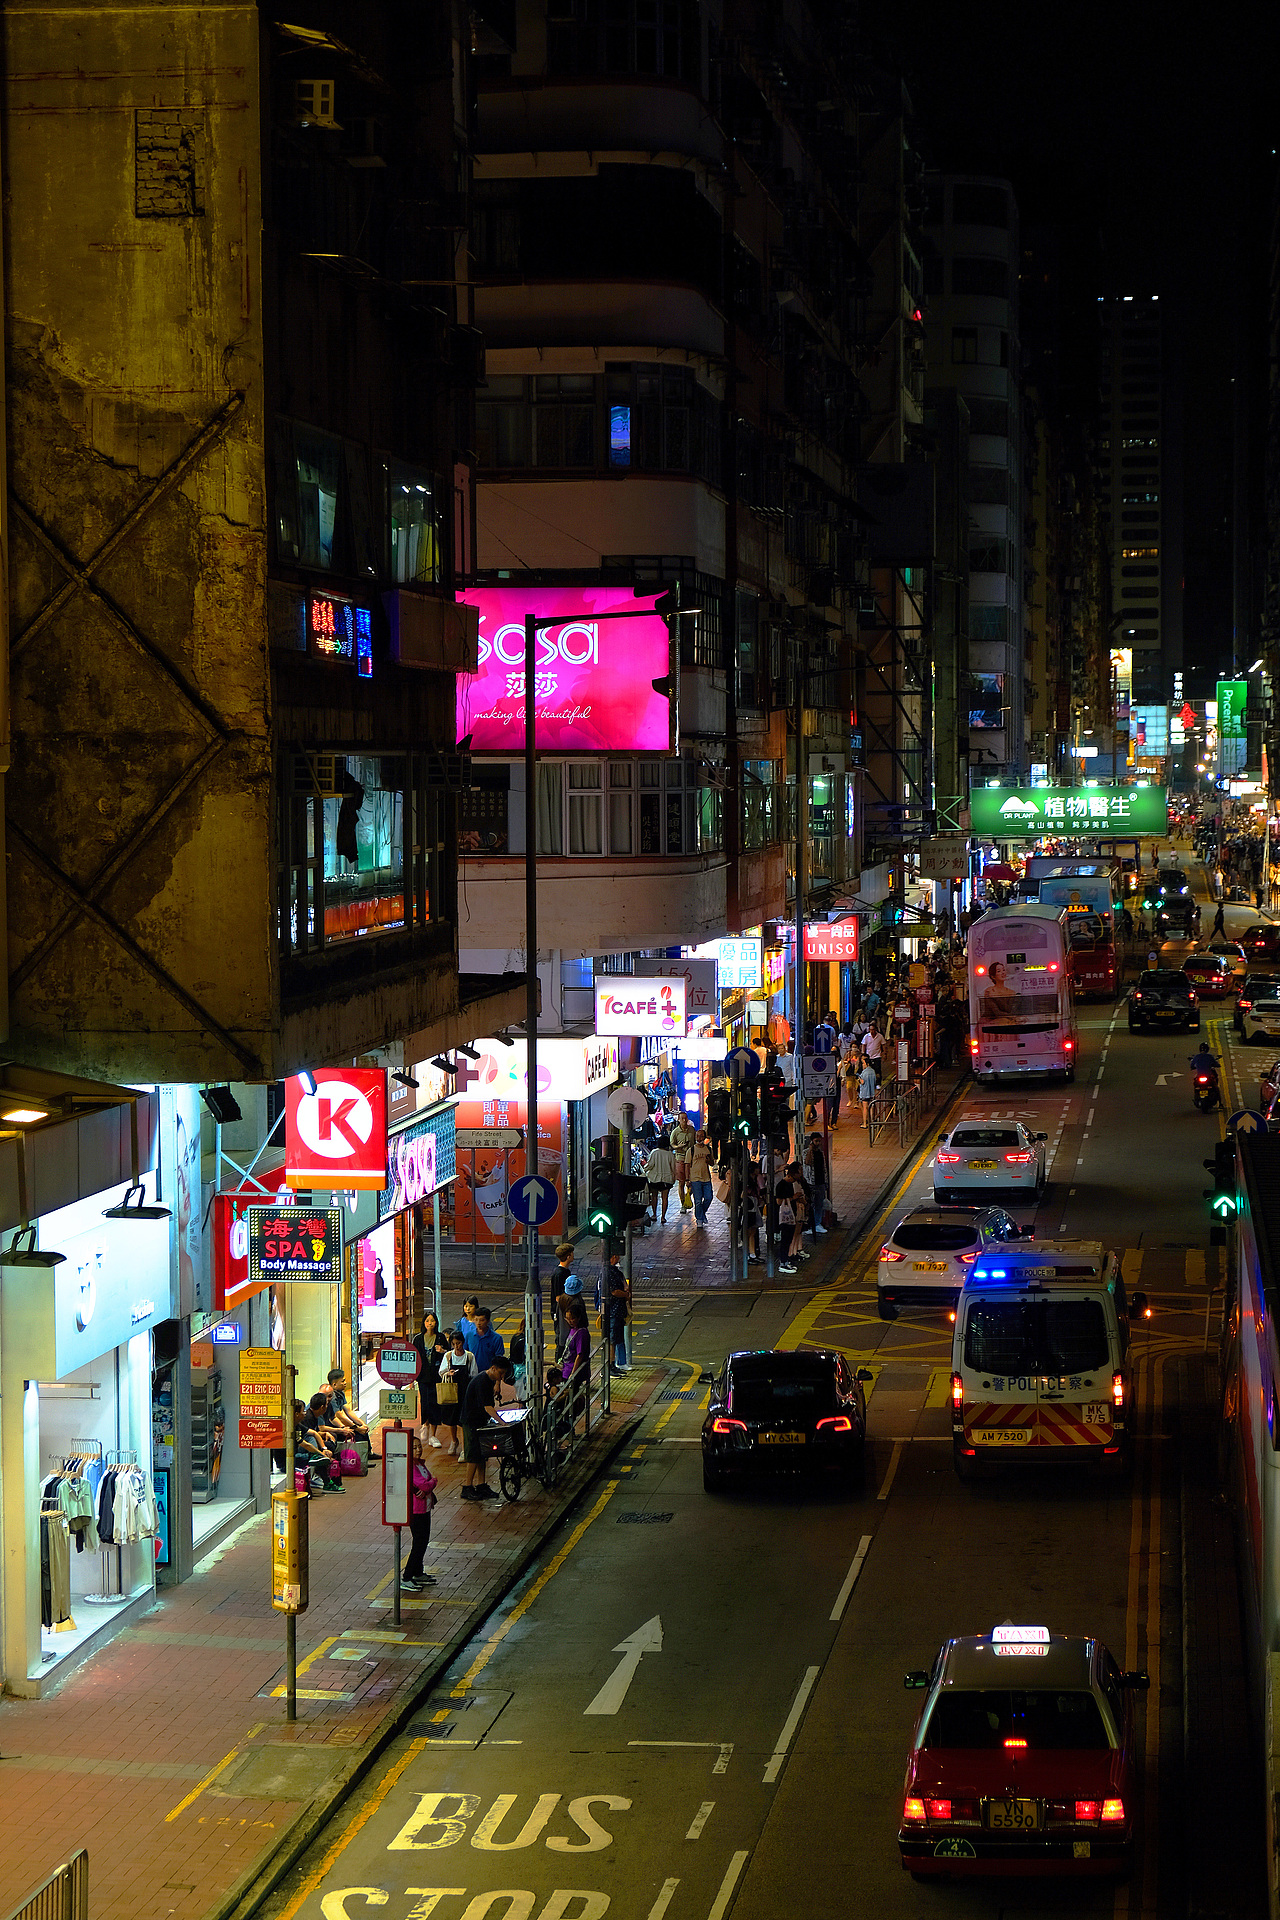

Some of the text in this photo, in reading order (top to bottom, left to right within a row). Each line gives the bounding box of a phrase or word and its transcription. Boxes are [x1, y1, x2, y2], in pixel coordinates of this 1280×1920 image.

[473, 706, 514, 725] making
[541, 706, 592, 725] beautiful
[1043, 796, 1131, 818] 植物醫生
[718, 942, 758, 962] 優品
[807, 943, 855, 955] UNISO
[717, 966, 758, 986] 藥房
[824, 1075, 830, 1083] 7
[825, 1087, 835, 1095] 12
[318, 1098, 361, 1141] K
[960, 1110, 1040, 1120] BUS
[262, 1218, 328, 1239] 海灣
[264, 1240, 308, 1259] SPA
[260, 1259, 332, 1272] Body Massage
[927, 1263, 947, 1272] 7937
[1024, 1269, 1046, 1277] POLICE
[384, 1352, 414, 1362] 904 905
[992, 1376, 1082, 1391] 警 POLICE 察
[241, 1384, 281, 1394] E21 E21C E21D
[390, 1394, 404, 1403] 905
[241, 1405, 267, 1415] E21A E21B
[1087, 1405, 1103, 1414] MK
[1086, 1414, 1106, 1424] 3/5
[779, 1434, 799, 1443] 6314
[981, 1432, 1024, 1441] AM 7520
[997, 1630, 1045, 1640] TAXI
[1004, 1802, 1024, 1815] VN
[387, 1792, 634, 1853] BUS
[993, 1815, 1034, 1828] 5590
[950, 1843, 959, 1852] 4
